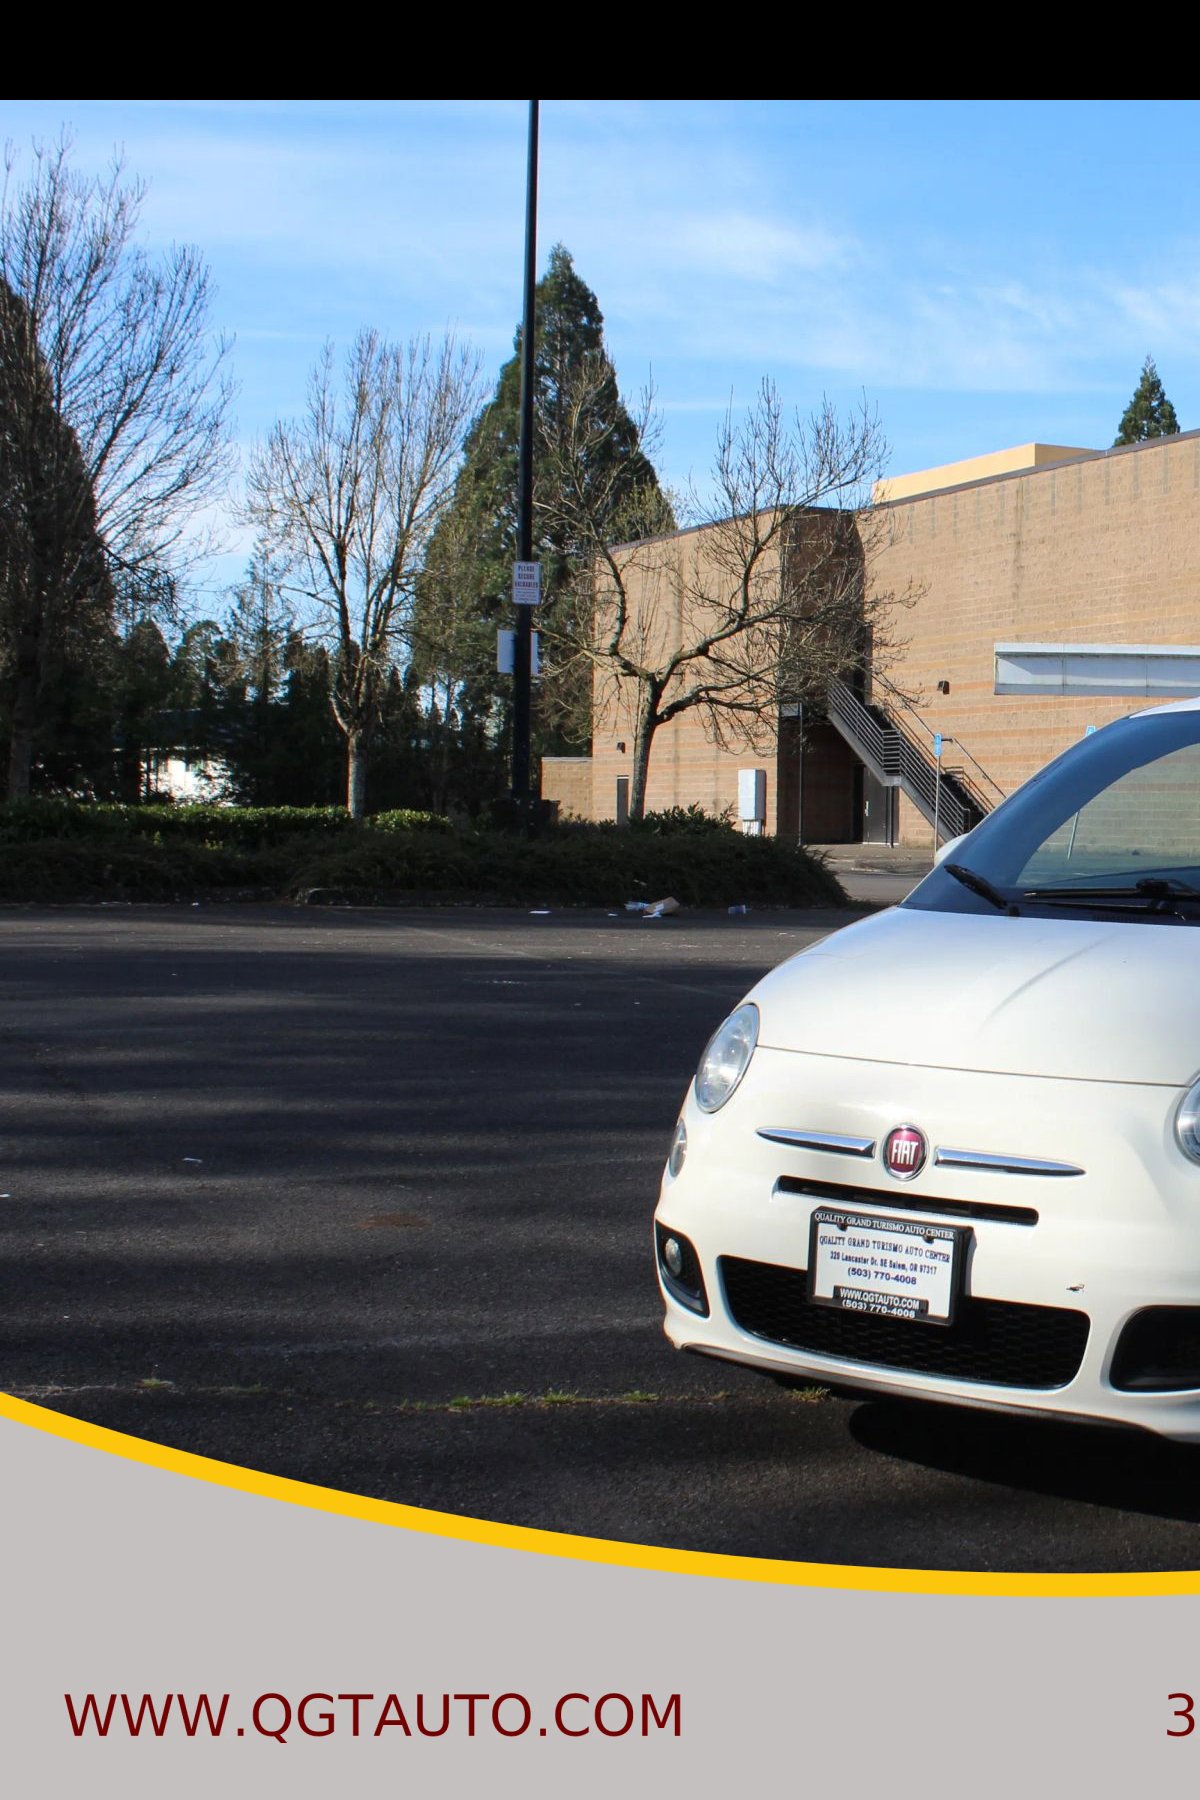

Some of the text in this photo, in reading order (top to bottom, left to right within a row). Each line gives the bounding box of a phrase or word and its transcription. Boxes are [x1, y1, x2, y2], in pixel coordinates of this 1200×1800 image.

[891, 1139, 918, 1165] FIAT
[815, 1212, 954, 1239] QUALITY GRAND TURISMO AUTO CENTER
[819, 1235, 950, 1263] QUALITY GRAND TURISMO AUTO CENTER
[841, 1252, 869, 1264] Lancaster
[880, 1259, 888, 1268] SE
[910, 1263, 918, 1272] OR
[920, 1265, 937, 1275] 97317
[848, 1267, 917, 1285] (503) 770-4008
[840, 1288, 919, 1309] WWW.QGTAUTO.COM
[842, 1299, 916, 1318] (503) 770-4008
